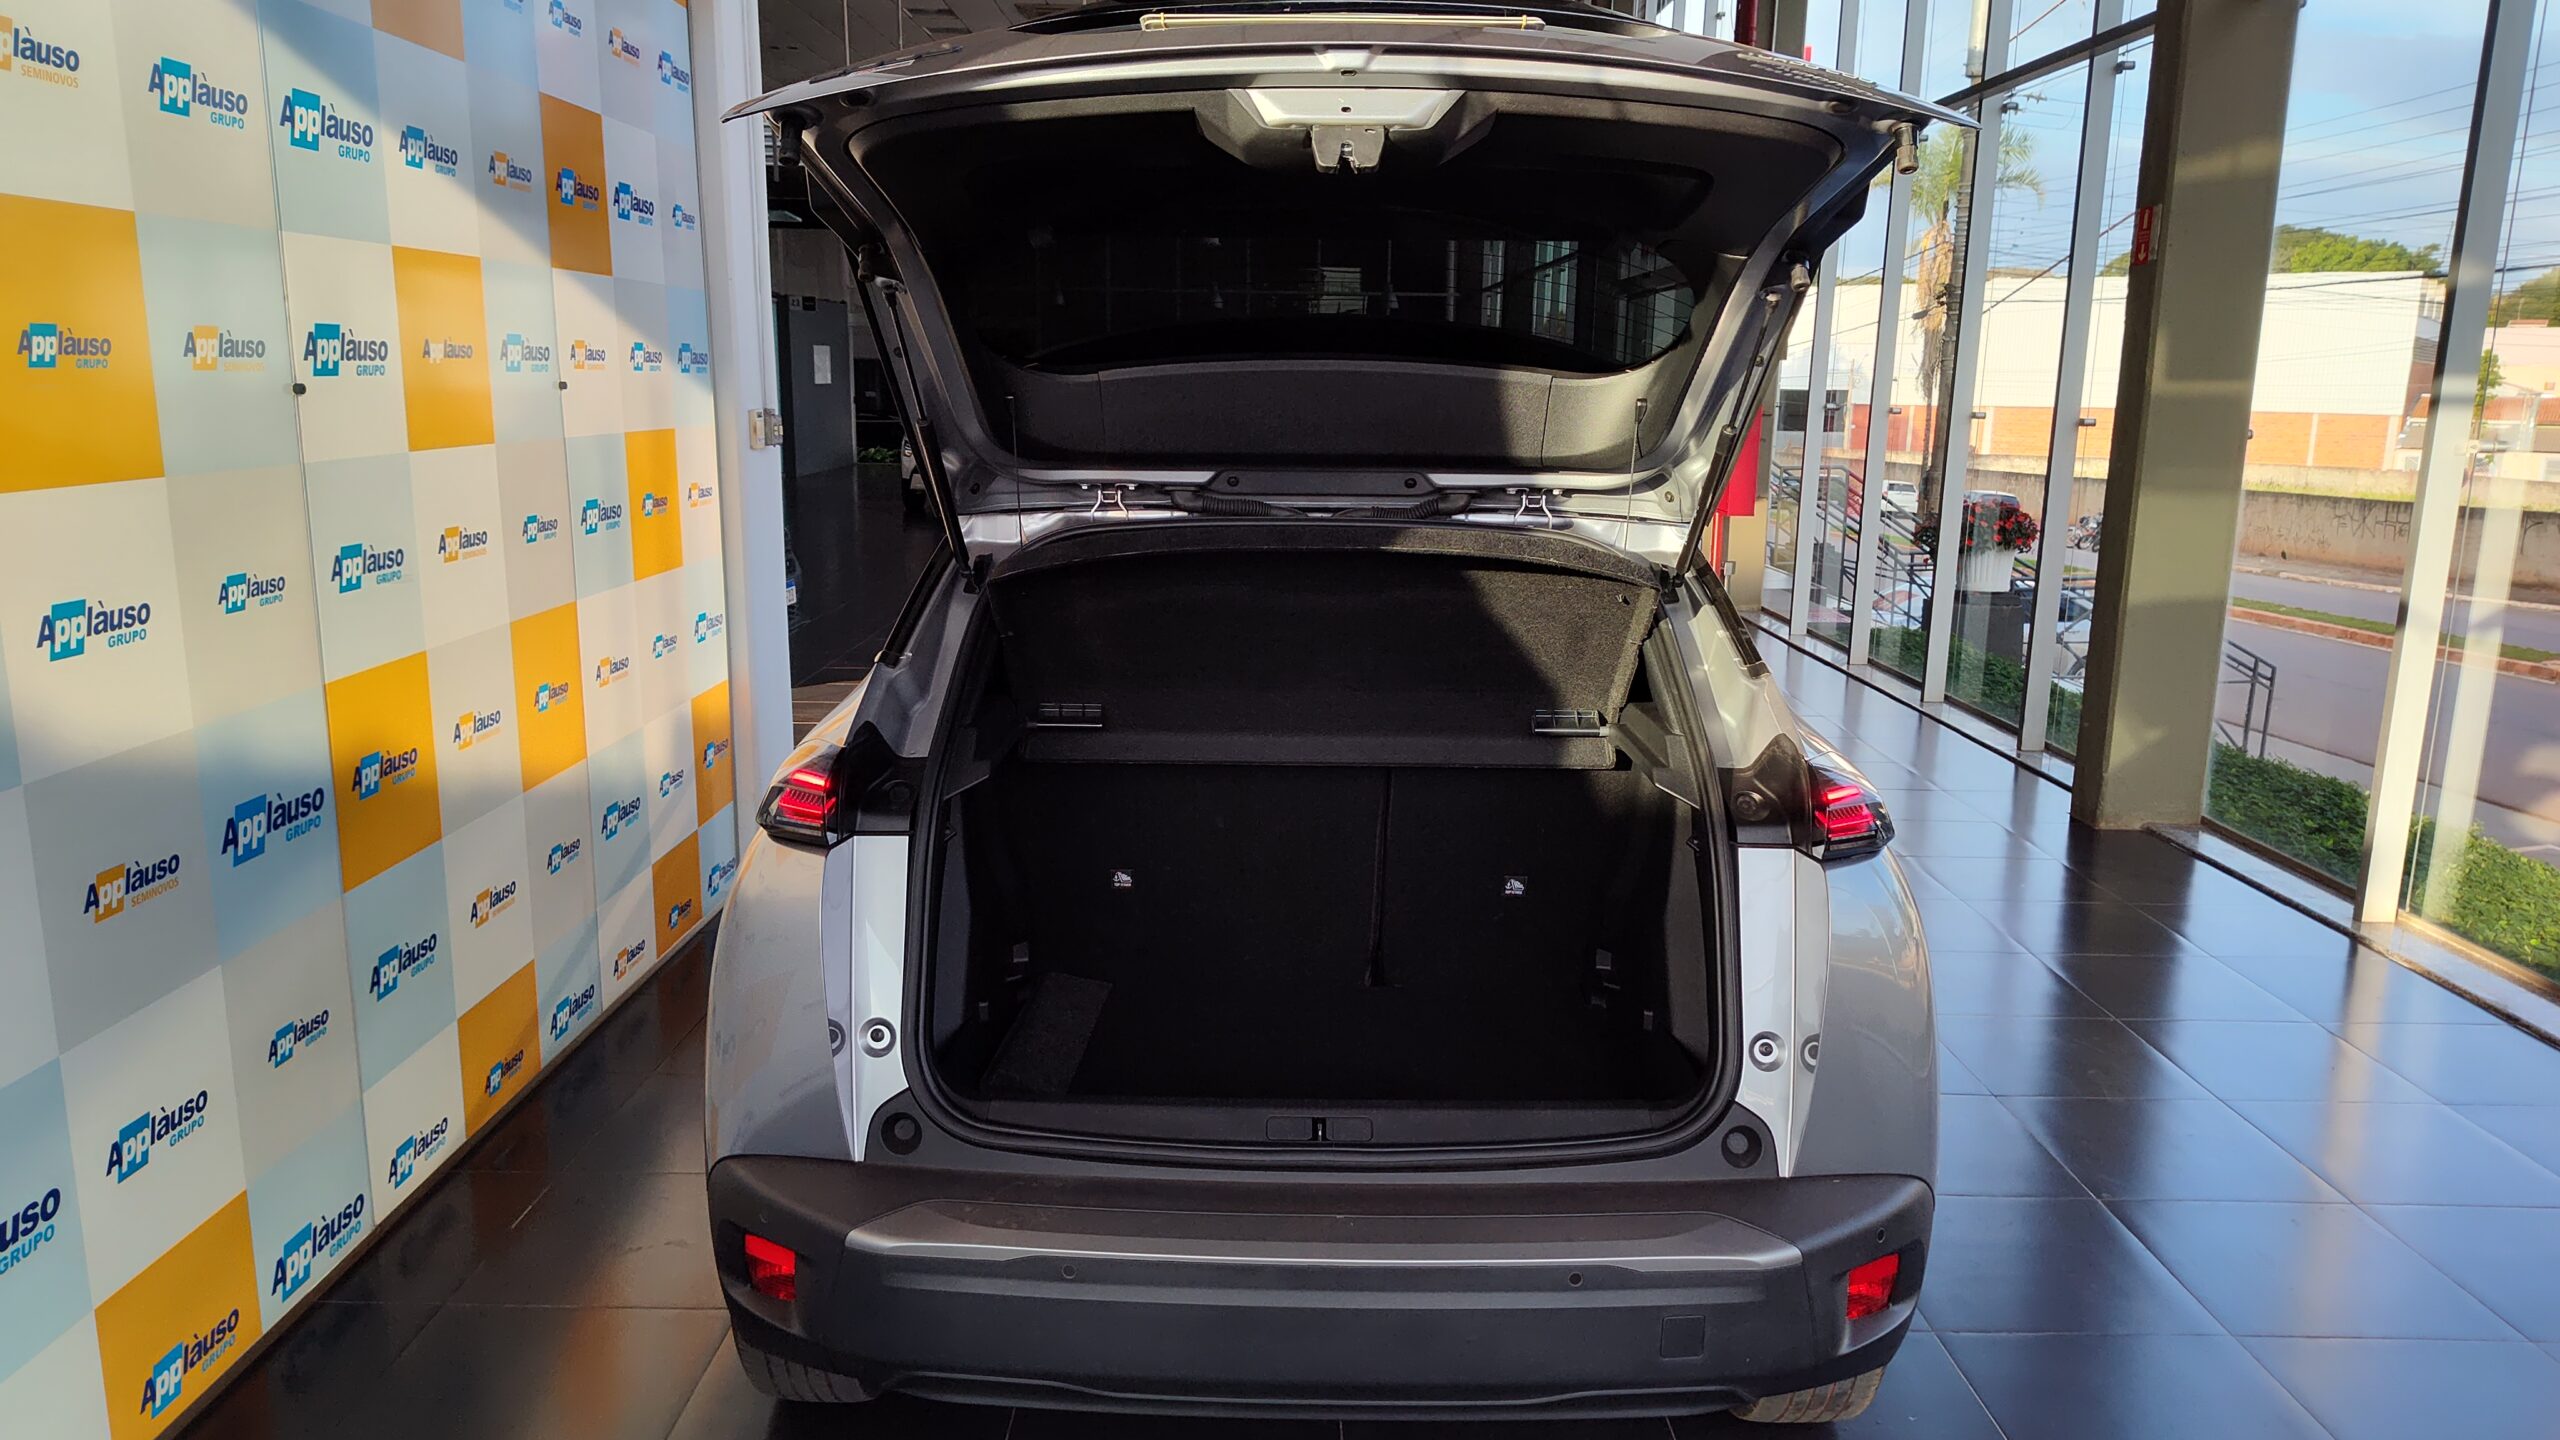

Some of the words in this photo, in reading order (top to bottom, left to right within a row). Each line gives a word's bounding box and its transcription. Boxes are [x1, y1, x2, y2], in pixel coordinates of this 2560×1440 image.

[21, 64, 78, 88] SEMINOVOS
[148, 63, 248, 115] Applàuso
[210, 111, 244, 130] GRUPO
[280, 94, 374, 148] Applàuso
[338, 145, 370, 163] GRUPO
[399, 130, 458, 166] Applàuso
[17, 328, 112, 361] Applàuso
[184, 330, 266, 365] Applàuso
[304, 329, 388, 370] Applàuso
[76, 358, 108, 369] GRUPO
[356, 364, 386, 376] GRUPO
[331, 545, 404, 587] Applàuso
[376, 570, 402, 585] GRUPO
[218, 574, 286, 608] Applàuso
[260, 594, 283, 607] GRUPO
[37, 601, 151, 655] Applàuso
[108, 629, 147, 649] GRUPO
[352, 747, 418, 793] Applàuso
[221, 786, 324, 858] Applàuso
[286, 816, 321, 842] GRUPO
[84, 852, 180, 914] Applàuso
[130, 876, 180, 908] SEMINOVOS
[369, 934, 437, 995] Applàuso
[411, 953, 435, 978] GRUPO
[268, 1009, 329, 1063] Applàuso
[305, 1026, 327, 1047] GRUPO
[106, 1090, 208, 1177] Applàuso
[169, 1115, 205, 1147] GRUPO
[389, 1117, 448, 1185] Applàuso
[271, 1193, 364, 1297] Applàuso
[329, 1220, 362, 1258] GRUPO
[141, 1308, 240, 1414] Applàuso
[201, 1334, 236, 1372] GRUPO
